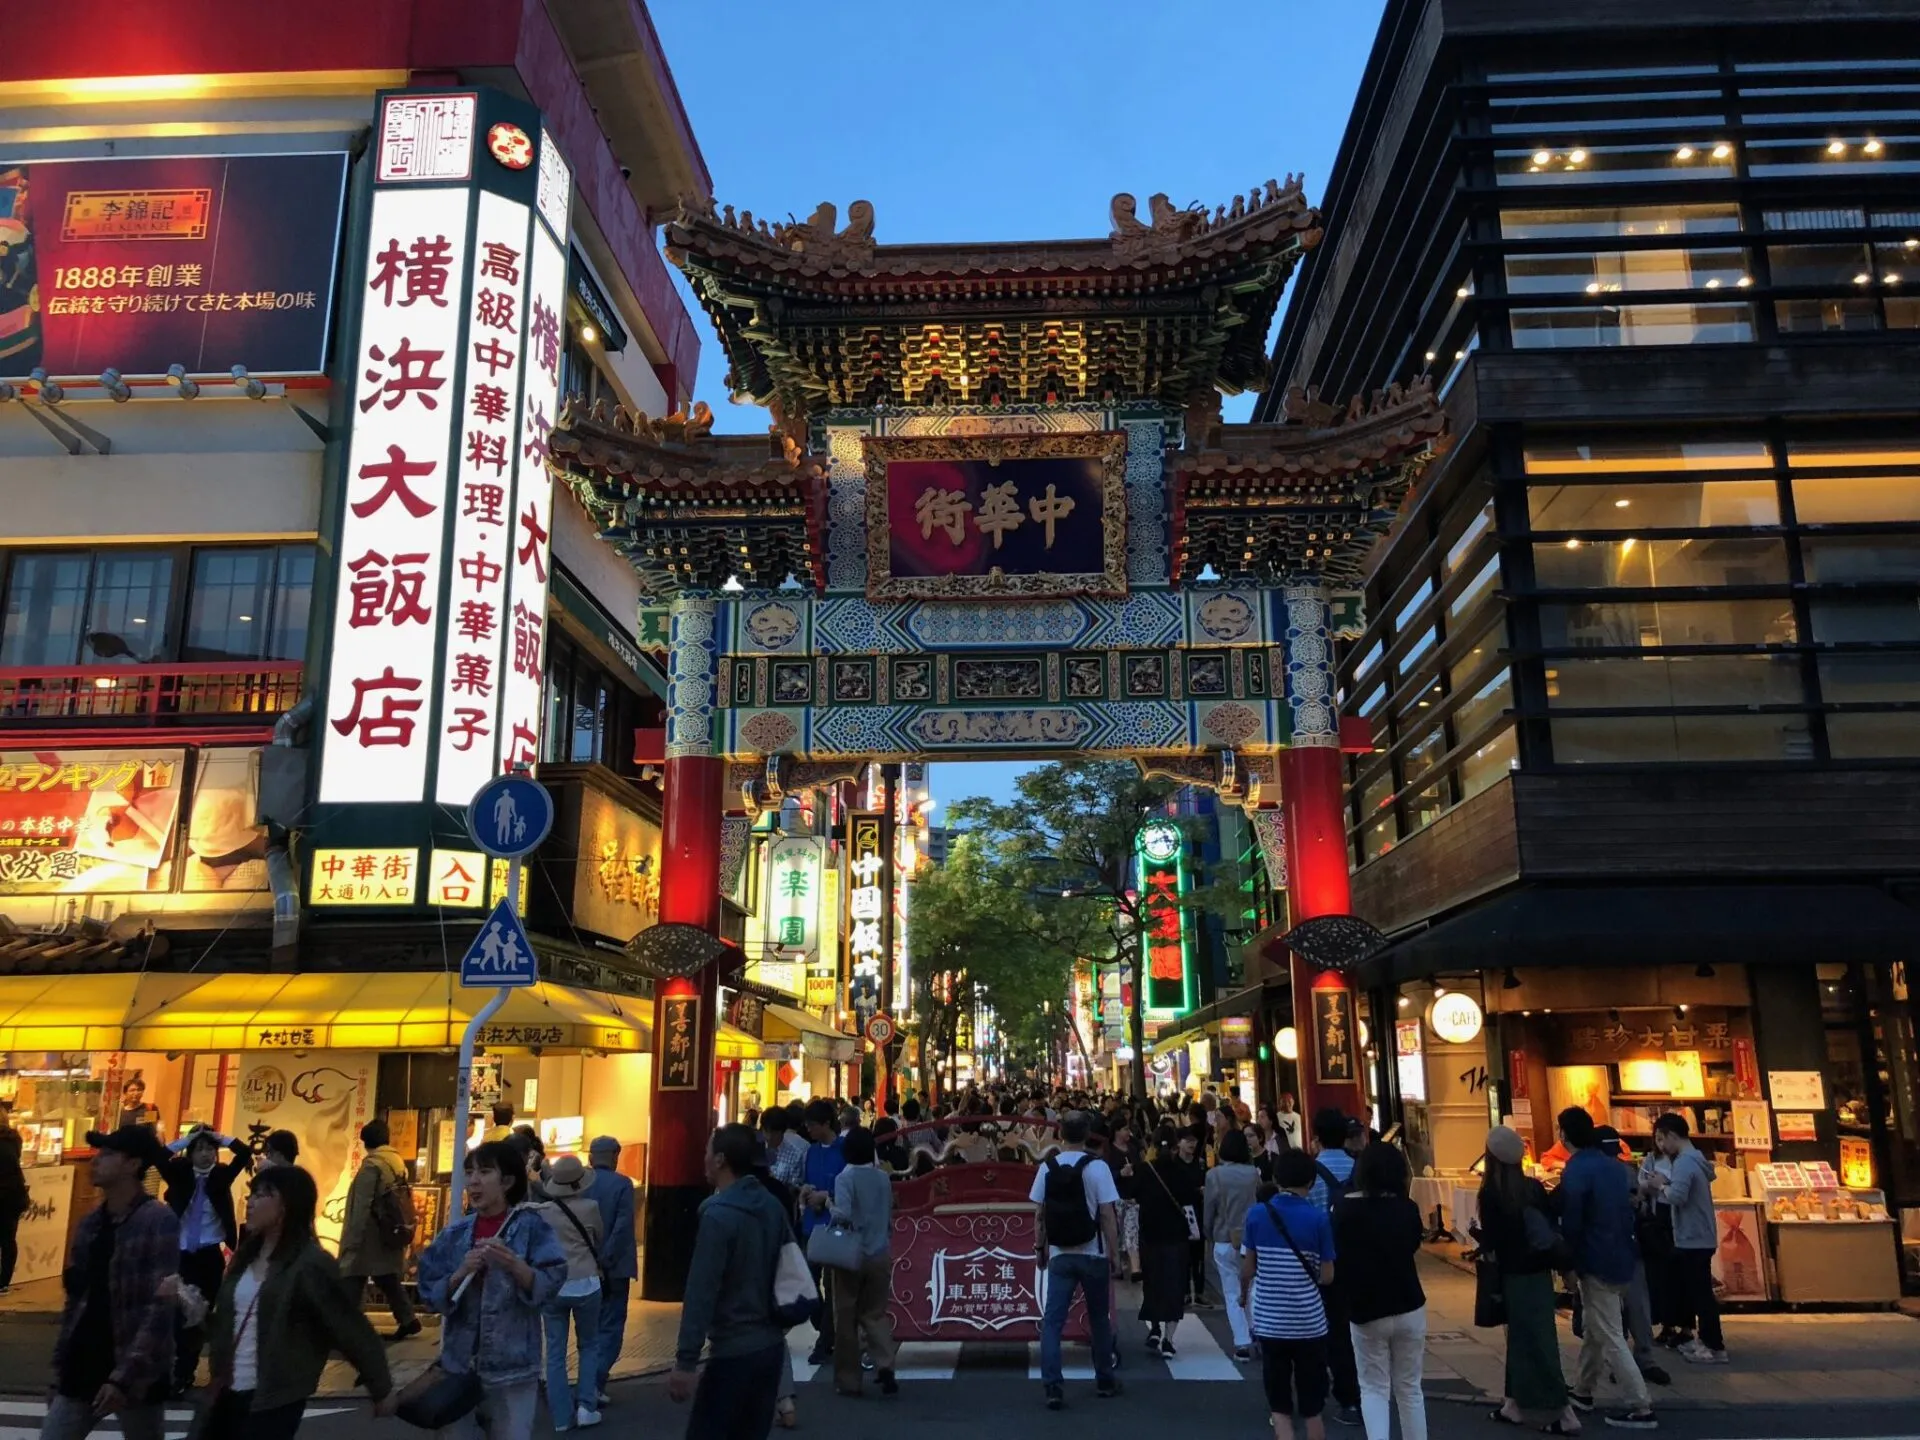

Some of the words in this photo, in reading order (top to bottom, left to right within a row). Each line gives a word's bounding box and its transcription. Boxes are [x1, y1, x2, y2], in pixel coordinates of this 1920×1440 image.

[100, 199, 175, 221] 李錦記
[54, 264, 203, 289] 1888年創業
[48, 290, 317, 315] 伝統を守り続けてきた本場の味
[330, 234, 453, 748] 横浜大飯店
[915, 480, 1076, 550] 中華街
[321, 854, 413, 881] 中華街
[440, 857, 476, 902] 入口
[317, 883, 409, 901] 大通り入口
[779, 868, 810, 946] 楽園
[872, 1023, 889, 1037] 30
[963, 1262, 1016, 1281] 不准
[945, 1282, 1035, 1301] 車馬駛入
